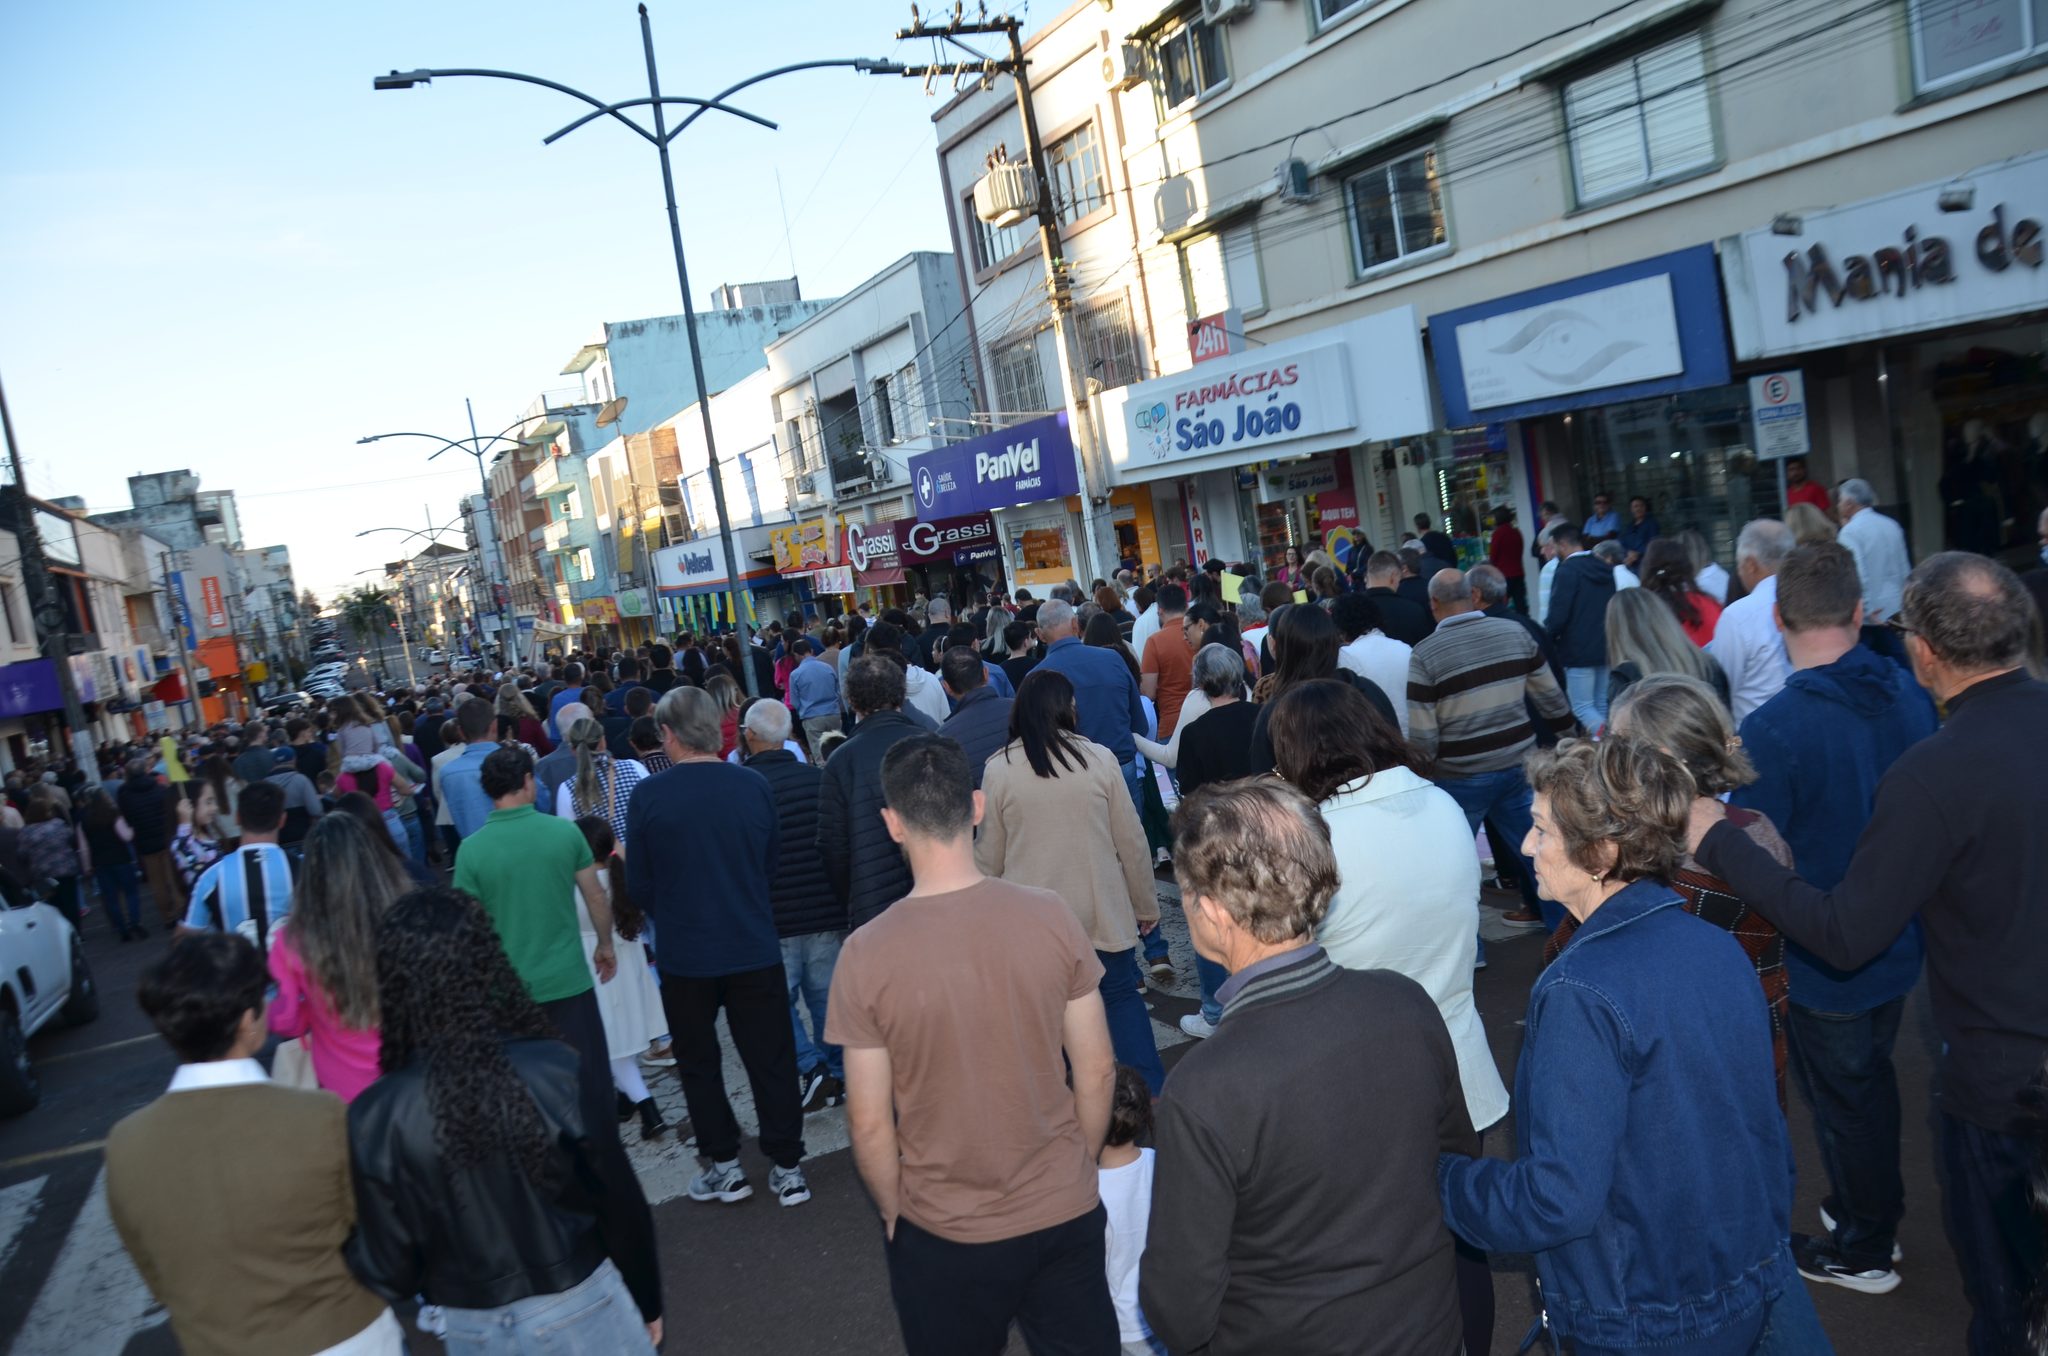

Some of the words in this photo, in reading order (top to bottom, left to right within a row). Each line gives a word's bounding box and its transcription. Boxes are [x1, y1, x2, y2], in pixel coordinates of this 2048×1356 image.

[1783, 223, 1957, 323] Mania
[1975, 202, 2043, 272] de
[1193, 321, 1226, 358] 24h
[1175, 363, 1299, 411] FARMÁCIAS
[1176, 408, 1225, 452] São
[1232, 392, 1301, 442] João
[937, 471, 953, 484] SAÚDE
[941, 481, 957, 494] BELEZA
[1015, 476, 1042, 492] FARMÁCIAS
[1321, 509, 1341, 522] AQUI
[848, 522, 897, 572] Grassi
[902, 519, 992, 555] Grassi
